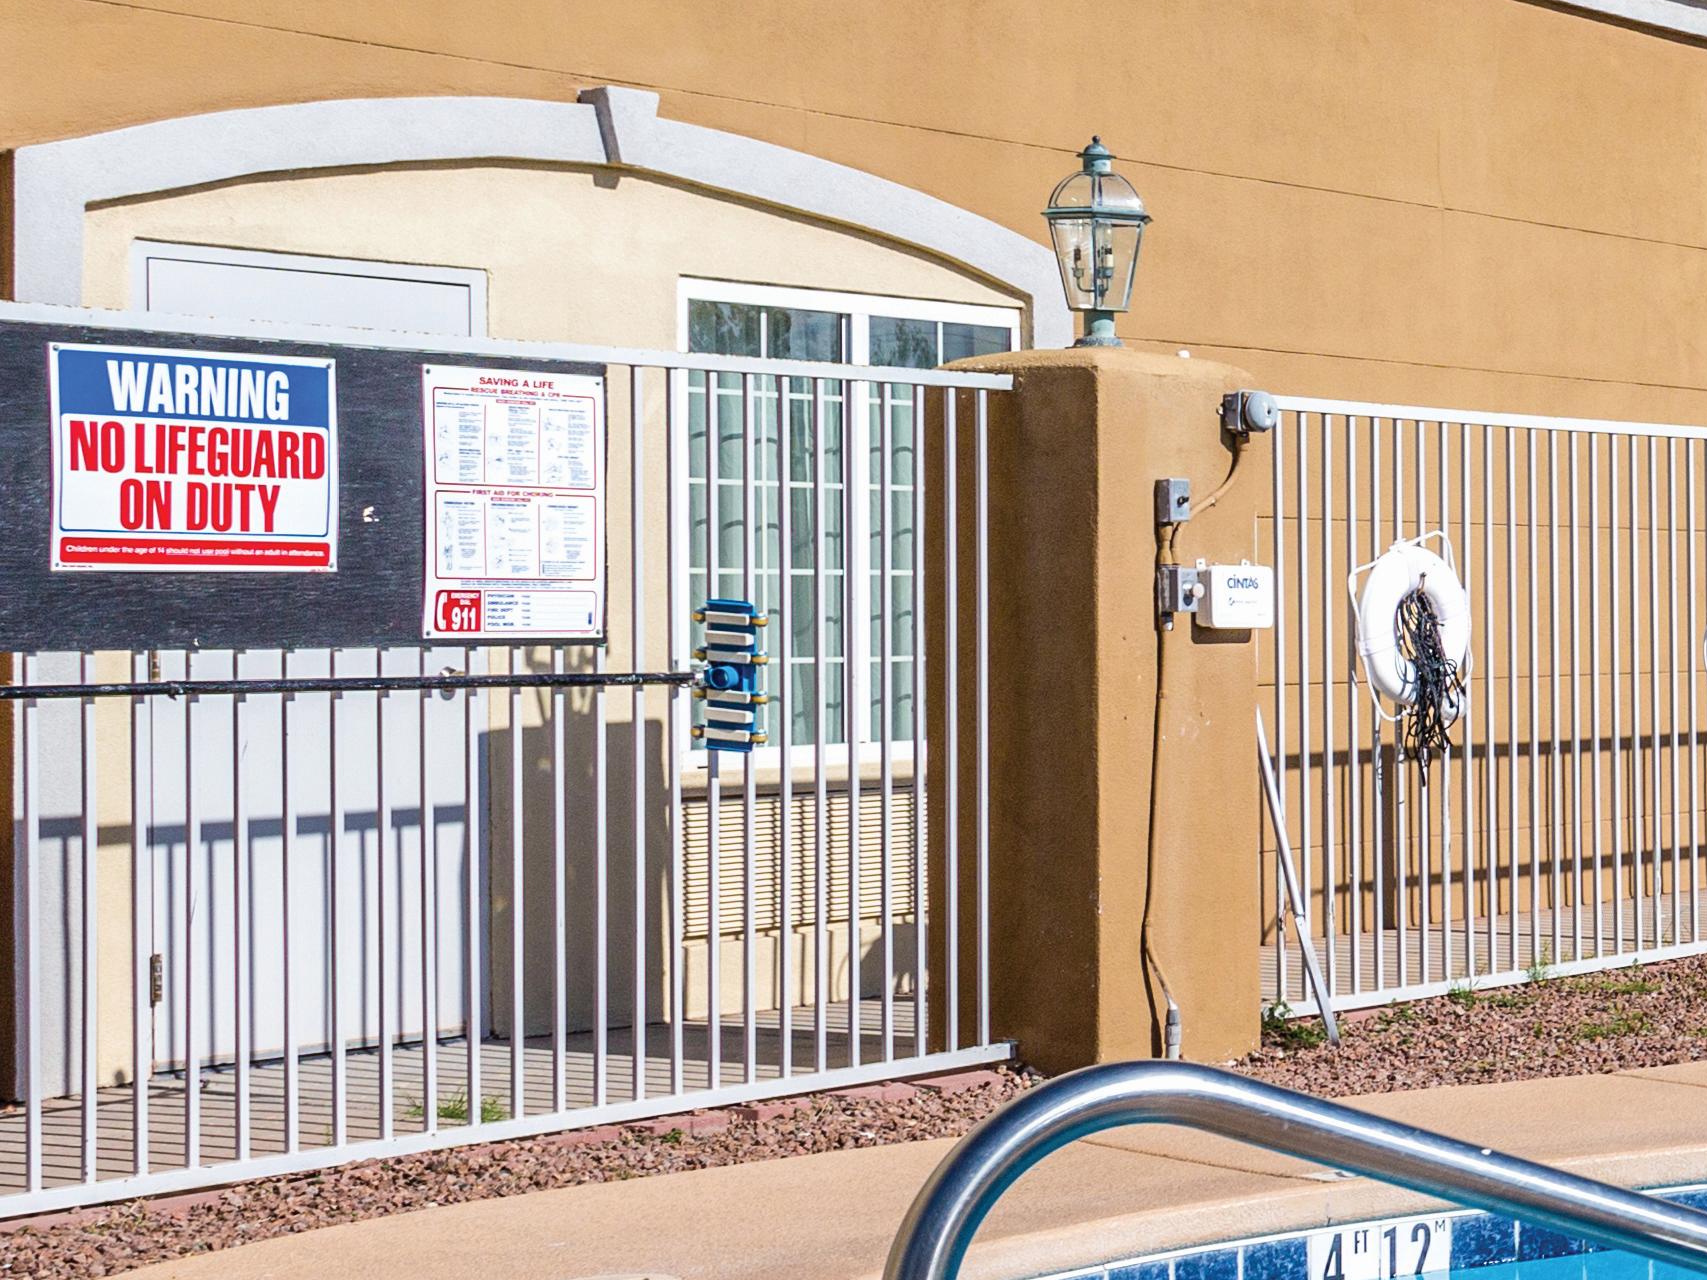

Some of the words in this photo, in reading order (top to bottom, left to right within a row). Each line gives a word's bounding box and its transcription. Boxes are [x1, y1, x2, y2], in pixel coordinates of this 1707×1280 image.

[106, 360, 290, 420] WARNING
[479, 376, 518, 387] SAVING
[533, 381, 554, 389] LIFE
[69, 421, 125, 473] NO
[135, 423, 325, 479] LIFEGUARD
[120, 479, 172, 530] ON
[186, 482, 281, 532] DUTY
[1227, 574, 1259, 589] CINTAS
[451, 607, 476, 630] 911
[1354, 1229, 1369, 1254] FT
[1434, 1219, 1446, 1233] M
